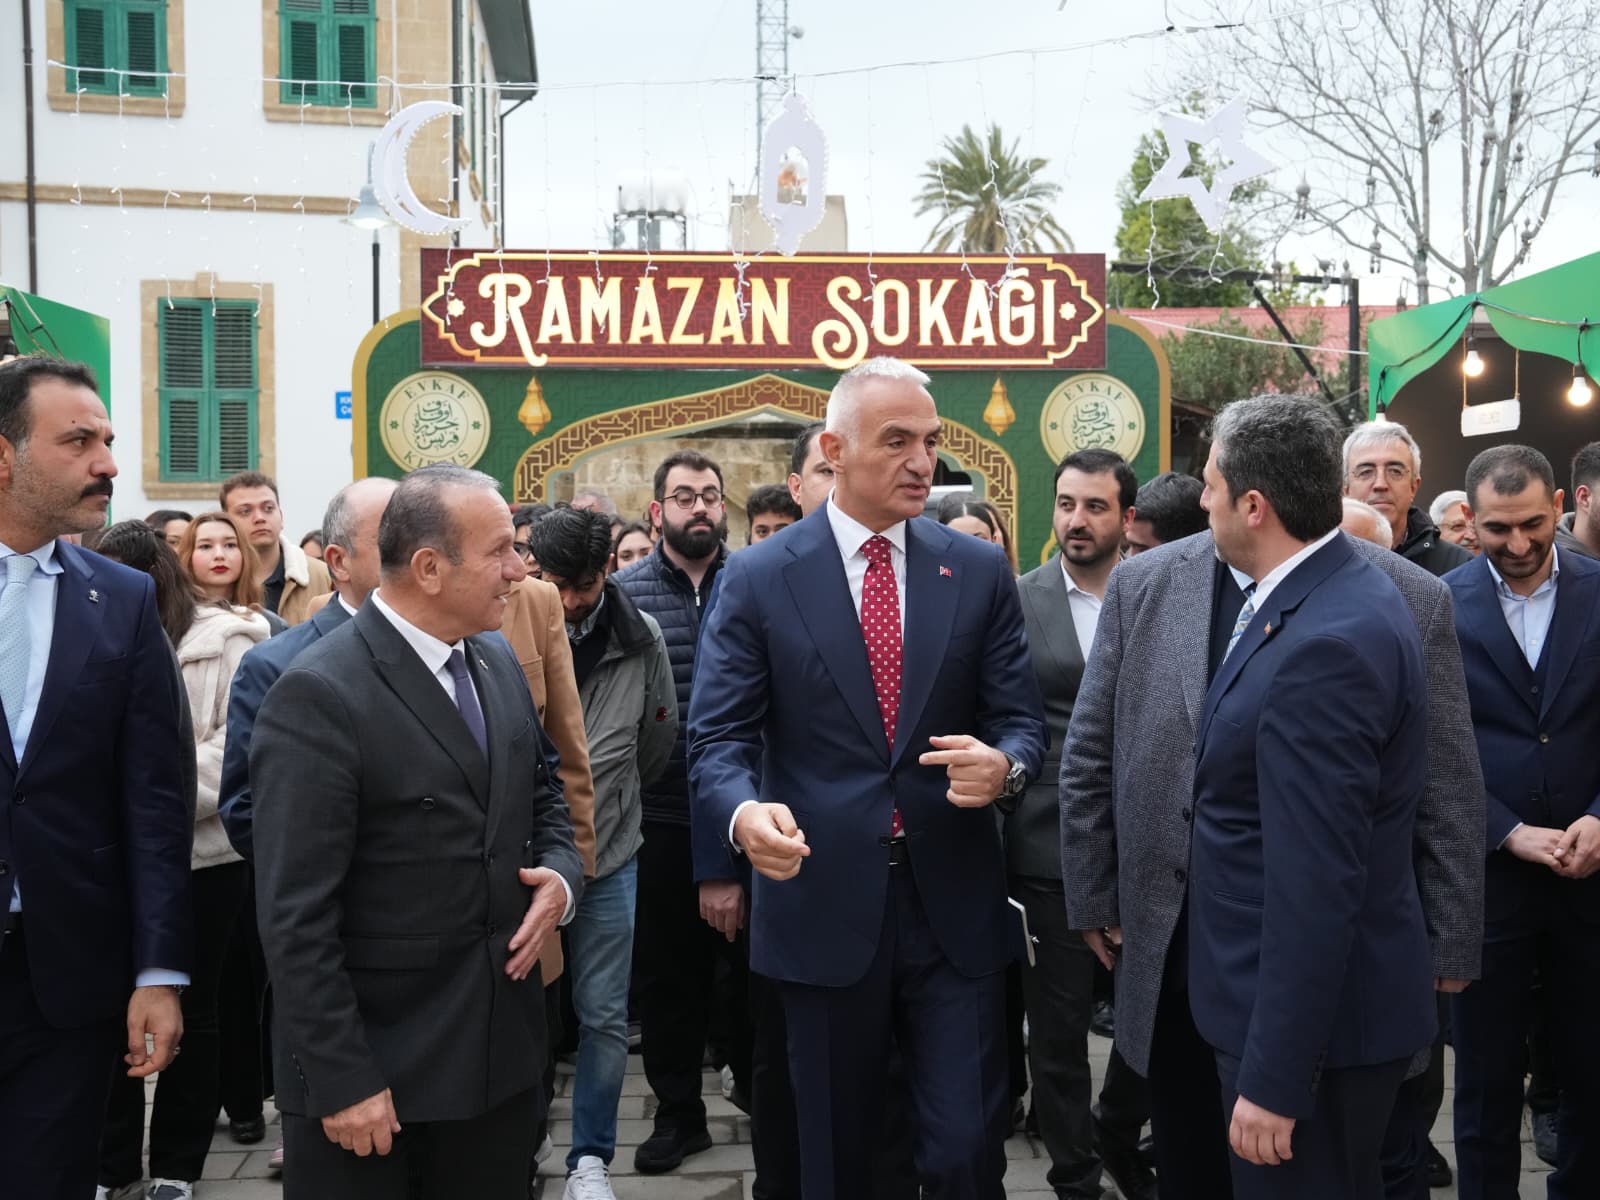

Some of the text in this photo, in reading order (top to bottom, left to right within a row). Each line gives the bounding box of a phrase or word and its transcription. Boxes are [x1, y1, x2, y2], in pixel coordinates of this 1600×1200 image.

[470, 267, 1056, 370] RAMAZAN SOKAĞI
[403, 379, 470, 399] EVKAF
[1063, 381, 1126, 401] EVKAF
